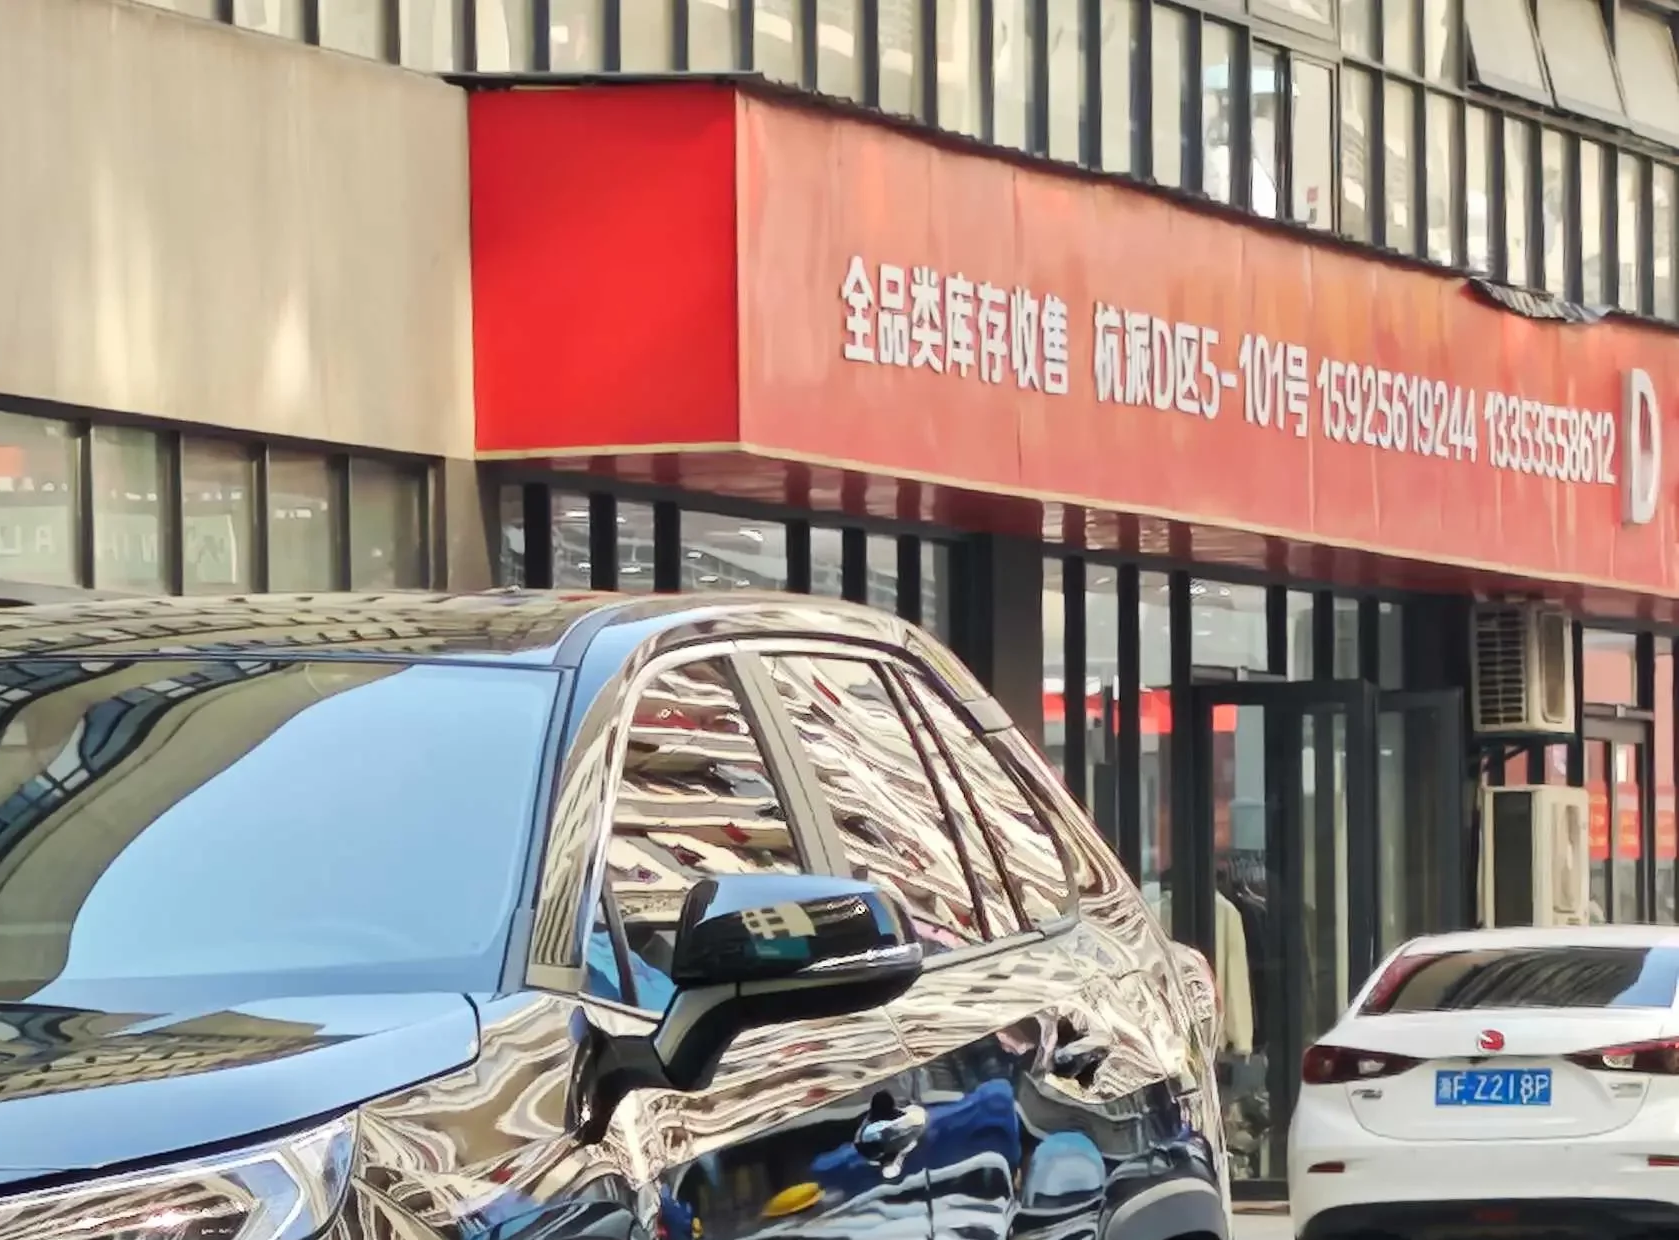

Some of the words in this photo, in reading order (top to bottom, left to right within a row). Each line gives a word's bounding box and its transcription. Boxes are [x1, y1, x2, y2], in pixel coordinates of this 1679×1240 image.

[840, 255, 1069, 395] 全品类库存收售
[1316, 356, 1478, 464] 15925619244
[1624, 368, 1663, 525] D
